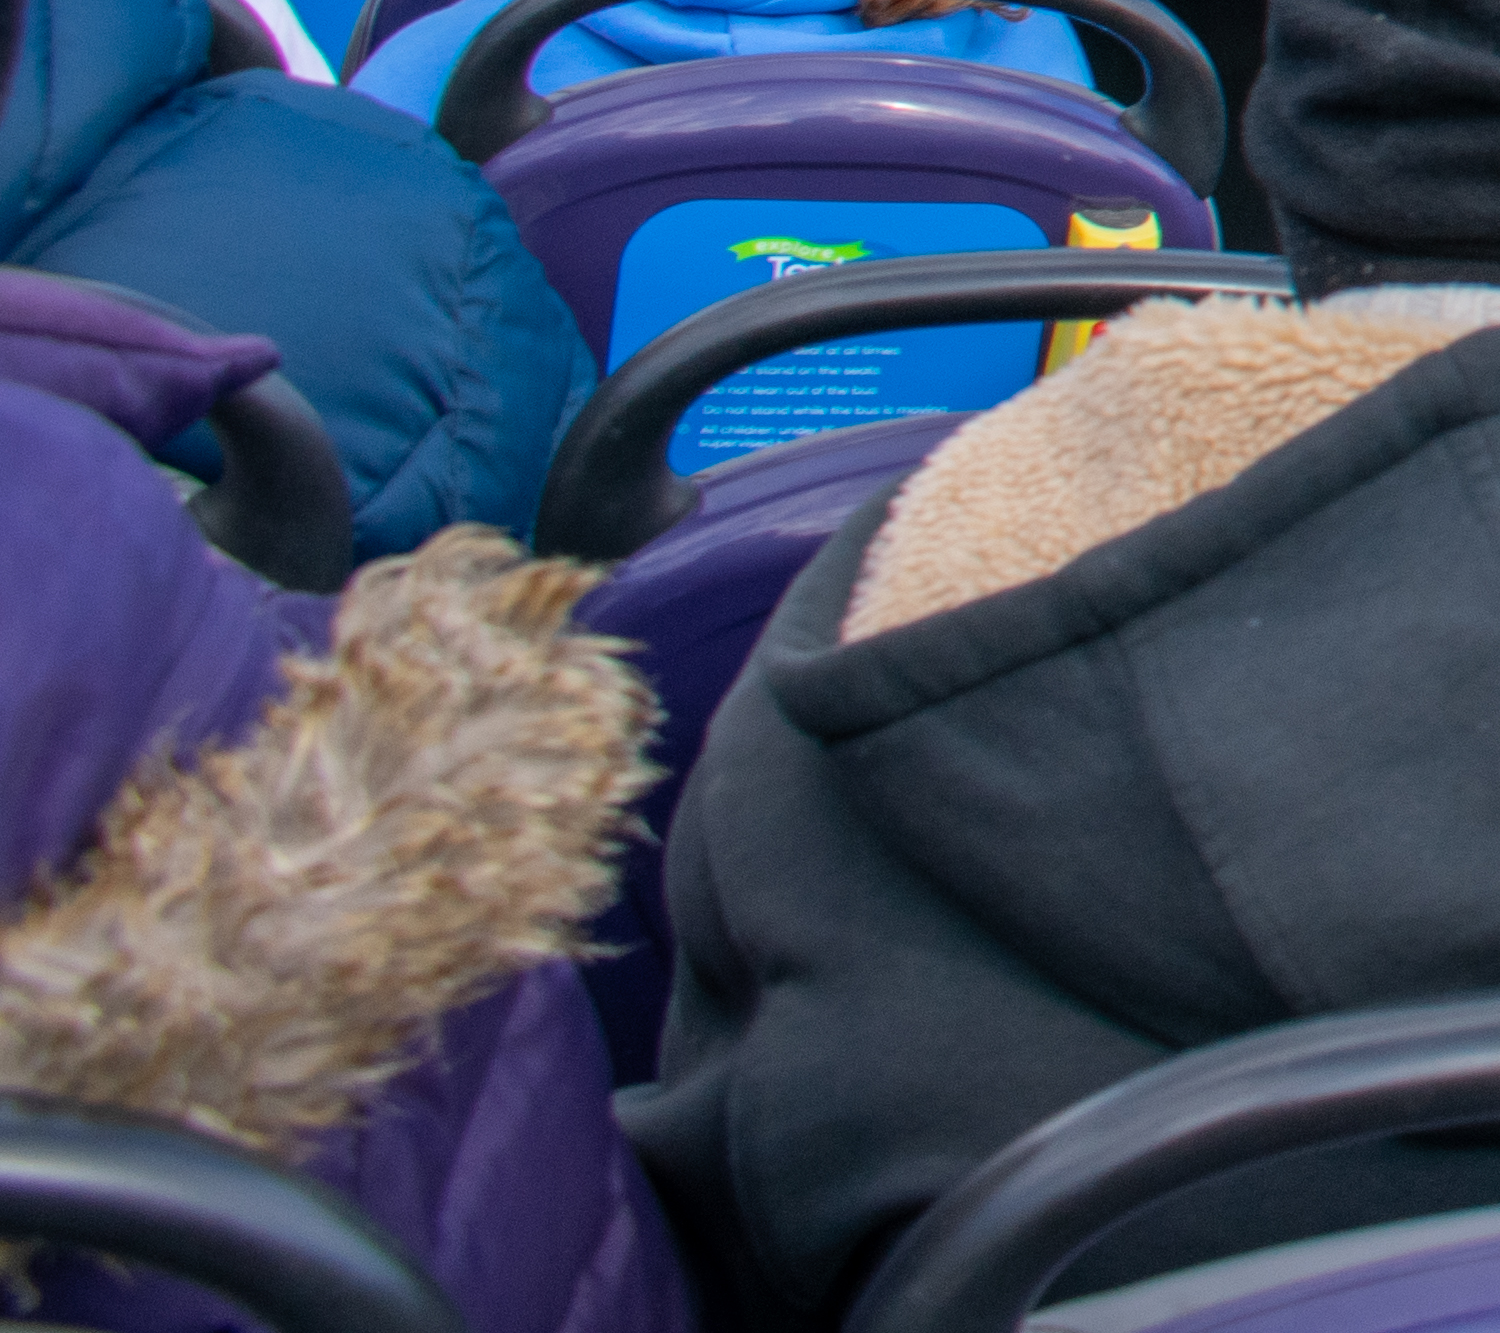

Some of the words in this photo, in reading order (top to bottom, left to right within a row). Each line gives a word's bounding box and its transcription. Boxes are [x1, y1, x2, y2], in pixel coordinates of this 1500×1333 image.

[755, 240, 835, 259] explore
[702, 406, 723, 415] Do
[725, 406, 749, 415] not
[751, 406, 790, 415] stand
[793, 406, 828, 415] while
[830, 406, 853, 415] the
[854, 406, 881, 415] bus
